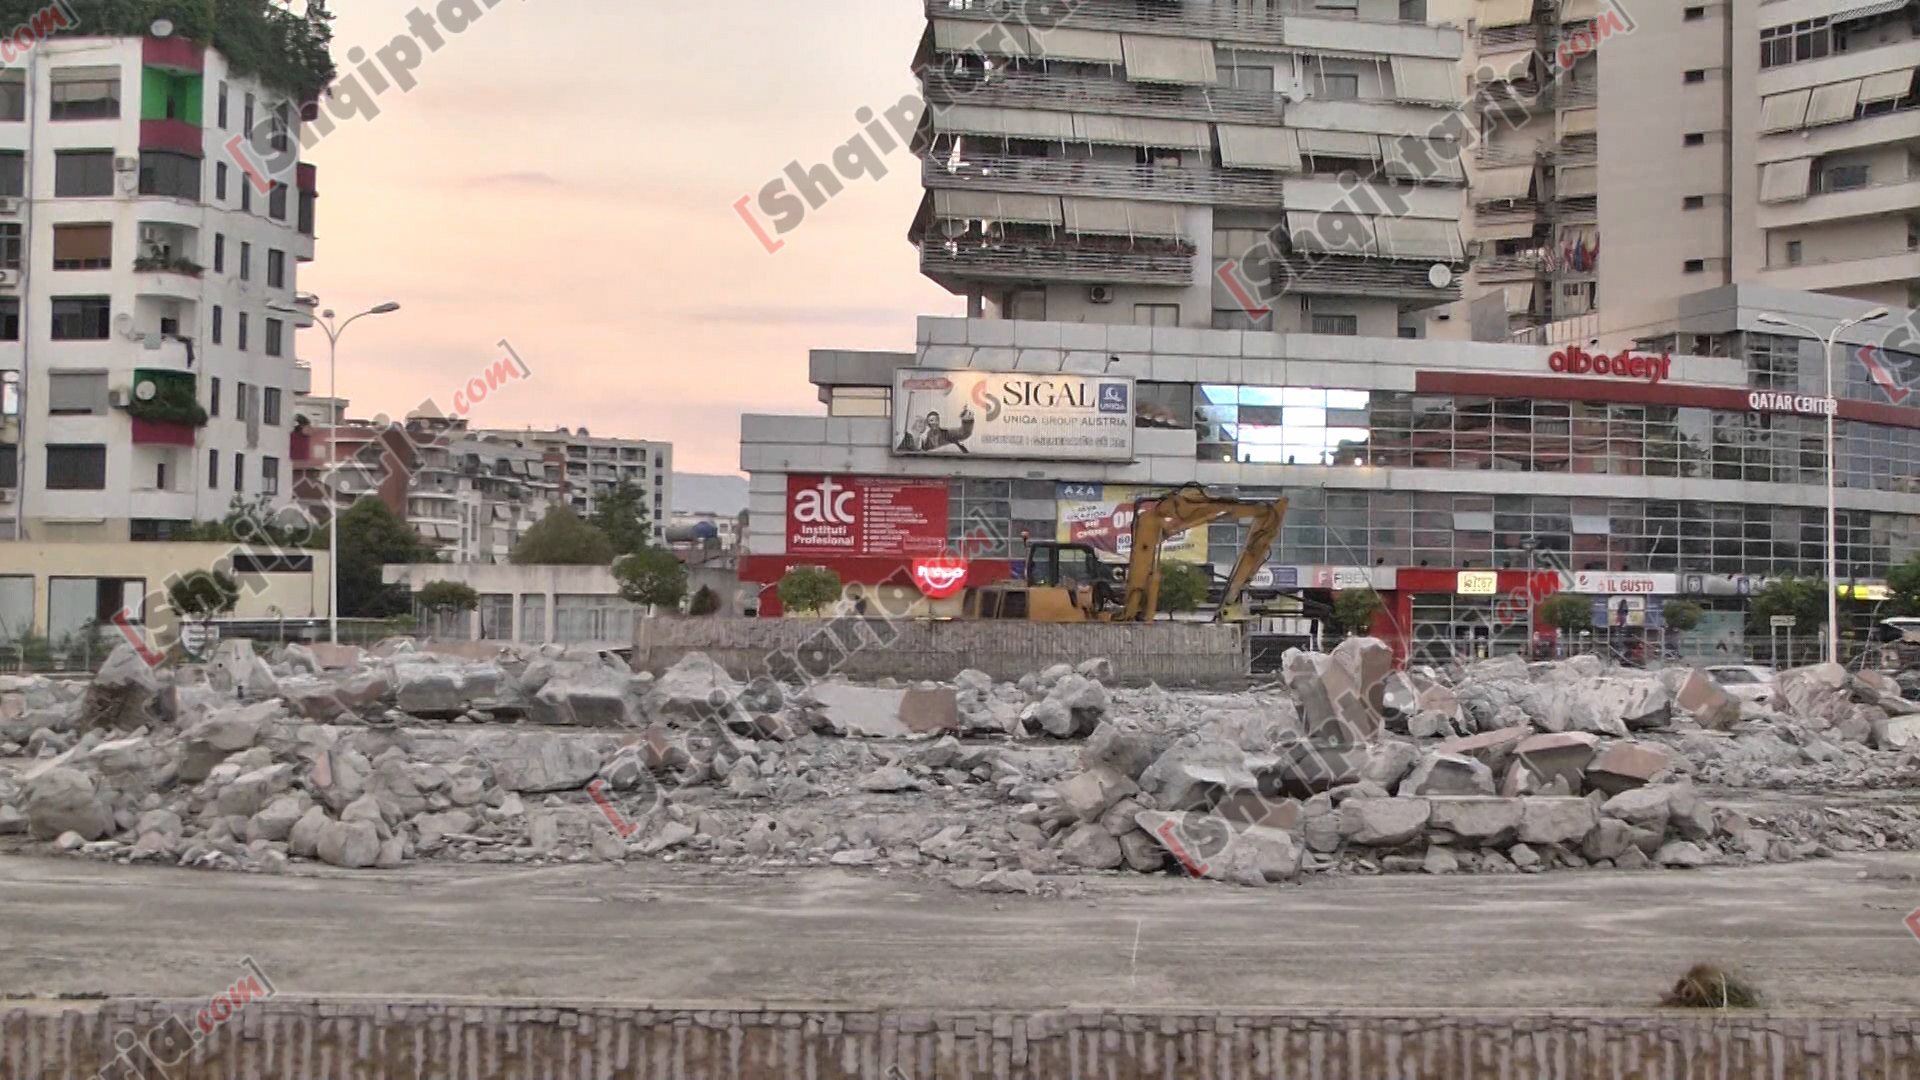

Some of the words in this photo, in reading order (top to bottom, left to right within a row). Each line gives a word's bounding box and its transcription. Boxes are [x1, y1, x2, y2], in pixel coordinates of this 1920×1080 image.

[1003, 381, 1095, 407] SIGAL
[1749, 393, 1792, 410] QATAR
[1794, 395, 1838, 415] CENTER
[1003, 415, 1037, 424] UNIQA
[1042, 416, 1078, 425] GROUP
[1080, 417, 1127, 426] AUSTRIA
[1064, 486, 1095, 496] AZA
[794, 476, 855, 524] atc
[802, 525, 847, 534] Instituti
[793, 535, 854, 546] Profesional
[1607, 580, 1617, 592] IL
[1620, 580, 1654, 592] GUSTO
